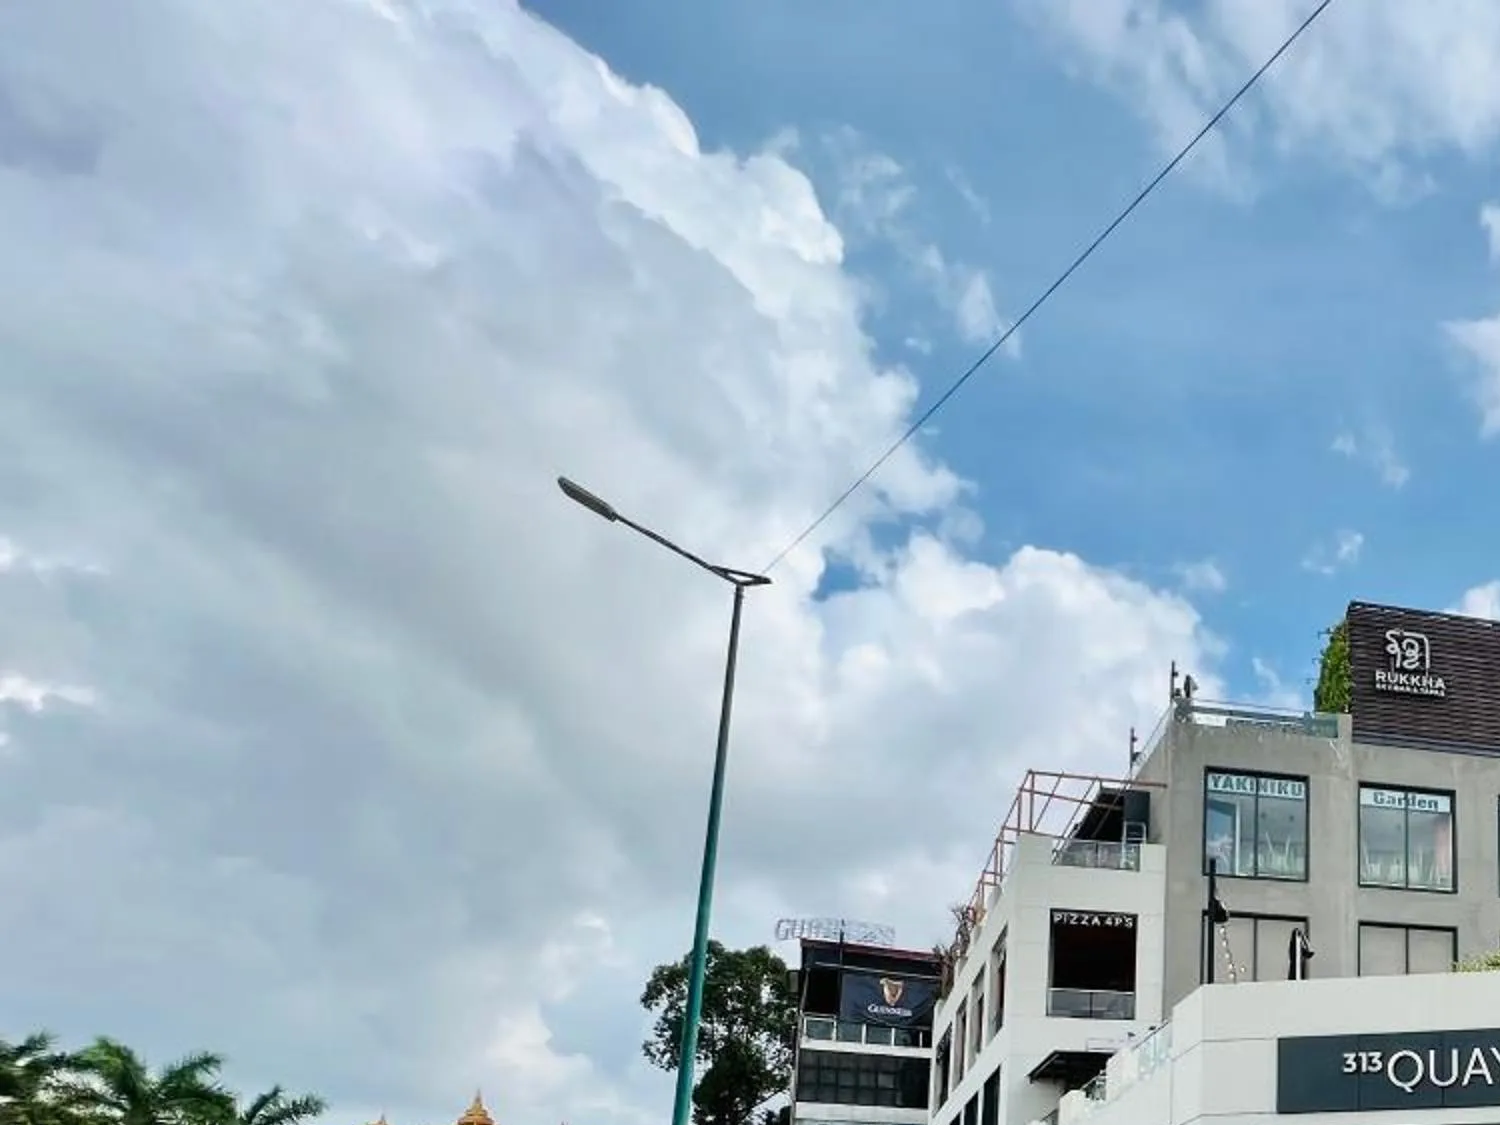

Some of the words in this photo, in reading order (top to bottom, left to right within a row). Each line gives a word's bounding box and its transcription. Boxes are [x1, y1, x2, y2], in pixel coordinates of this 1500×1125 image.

[1375, 671, 1447, 690] RUKKHA
[1211, 775, 1304, 797] YAKINIKU
[1373, 791, 1440, 811] Garden
[1053, 911, 1101, 926] PIZZA
[1342, 1052, 1383, 1073] 313
